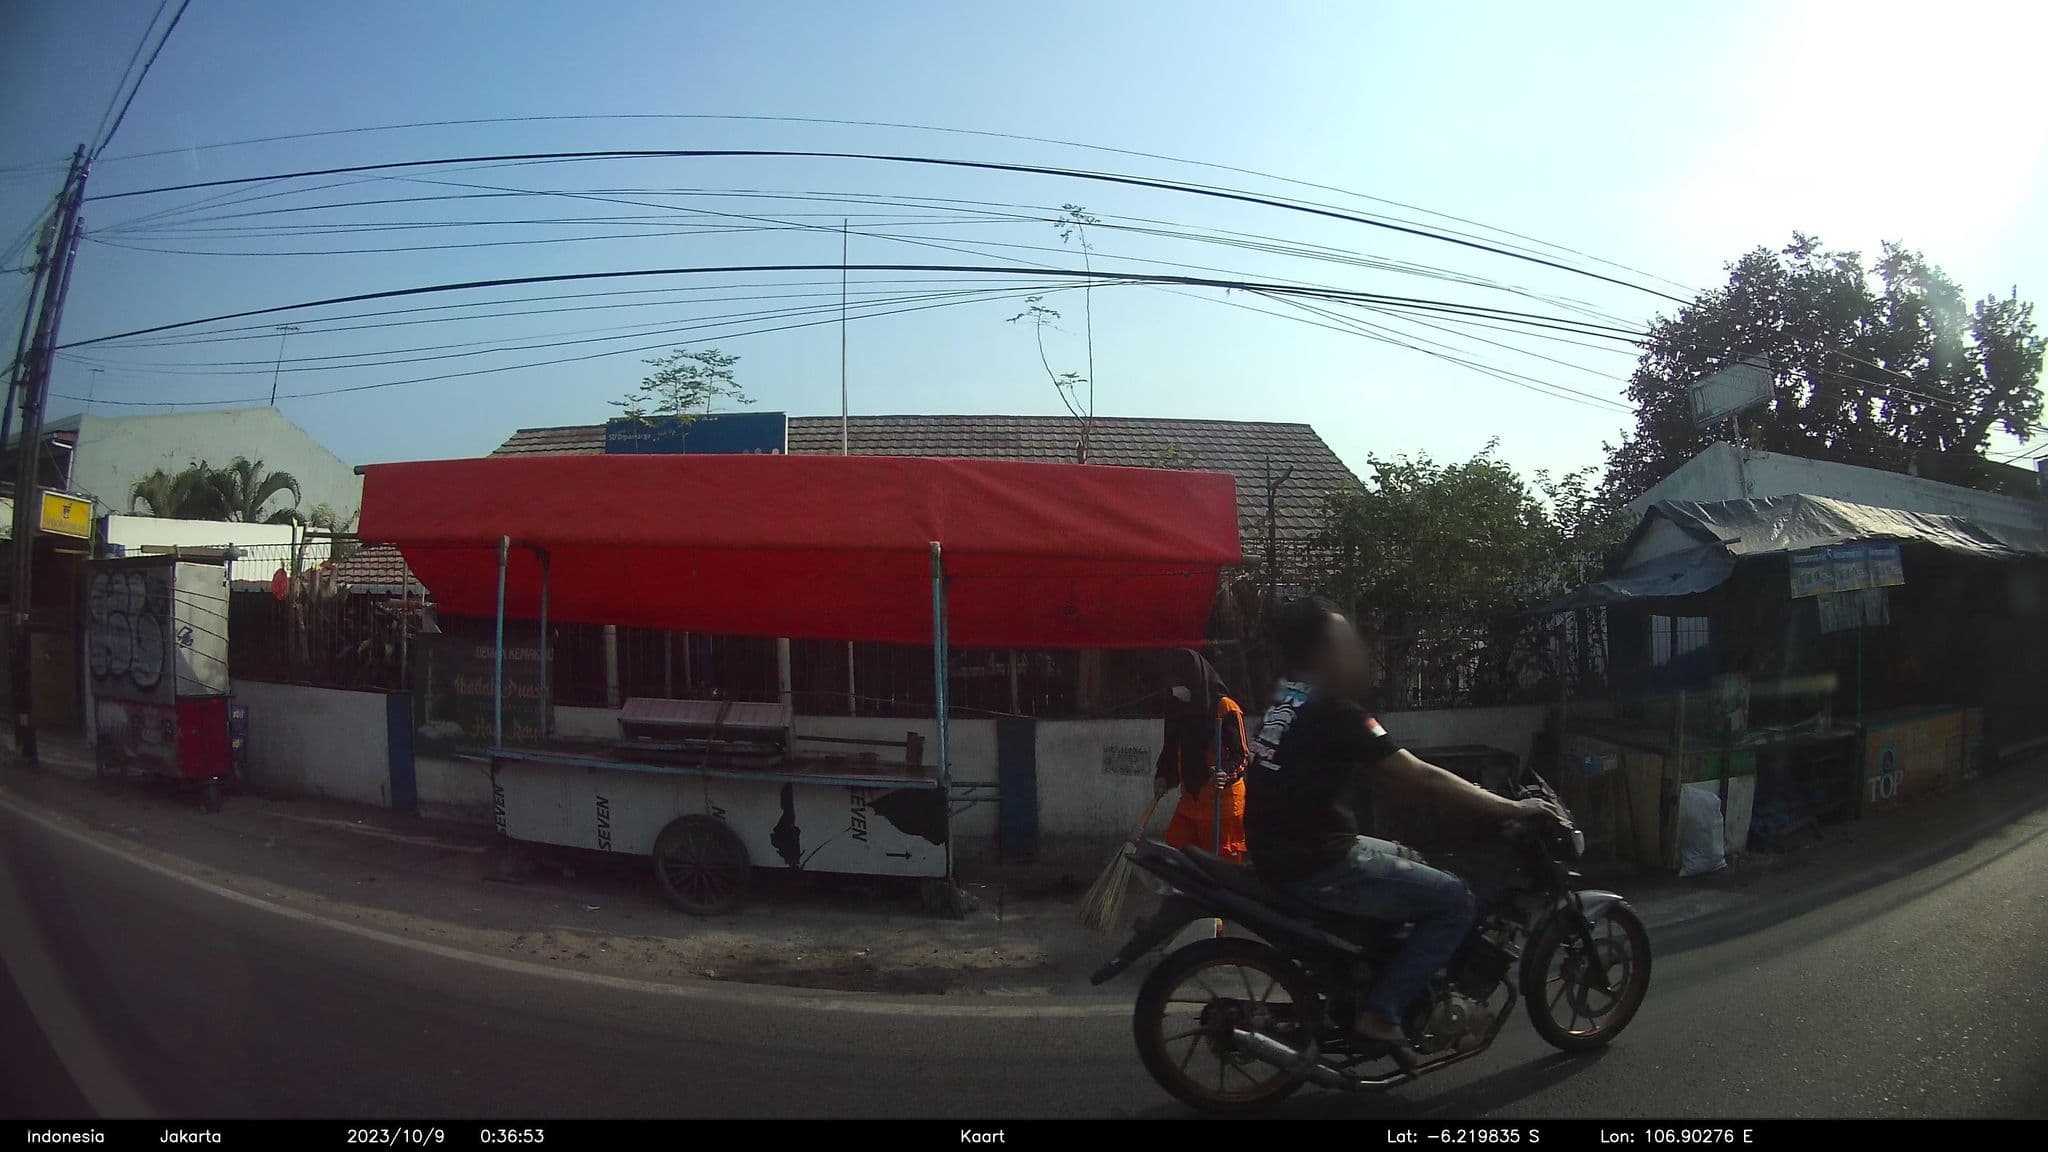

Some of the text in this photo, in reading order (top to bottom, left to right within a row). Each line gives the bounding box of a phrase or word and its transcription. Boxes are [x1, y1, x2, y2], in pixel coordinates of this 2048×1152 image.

[509, 647, 554, 661] KEMAKU
[1867, 769, 1904, 802] TOP
[595, 794, 612, 854] SEVEN
